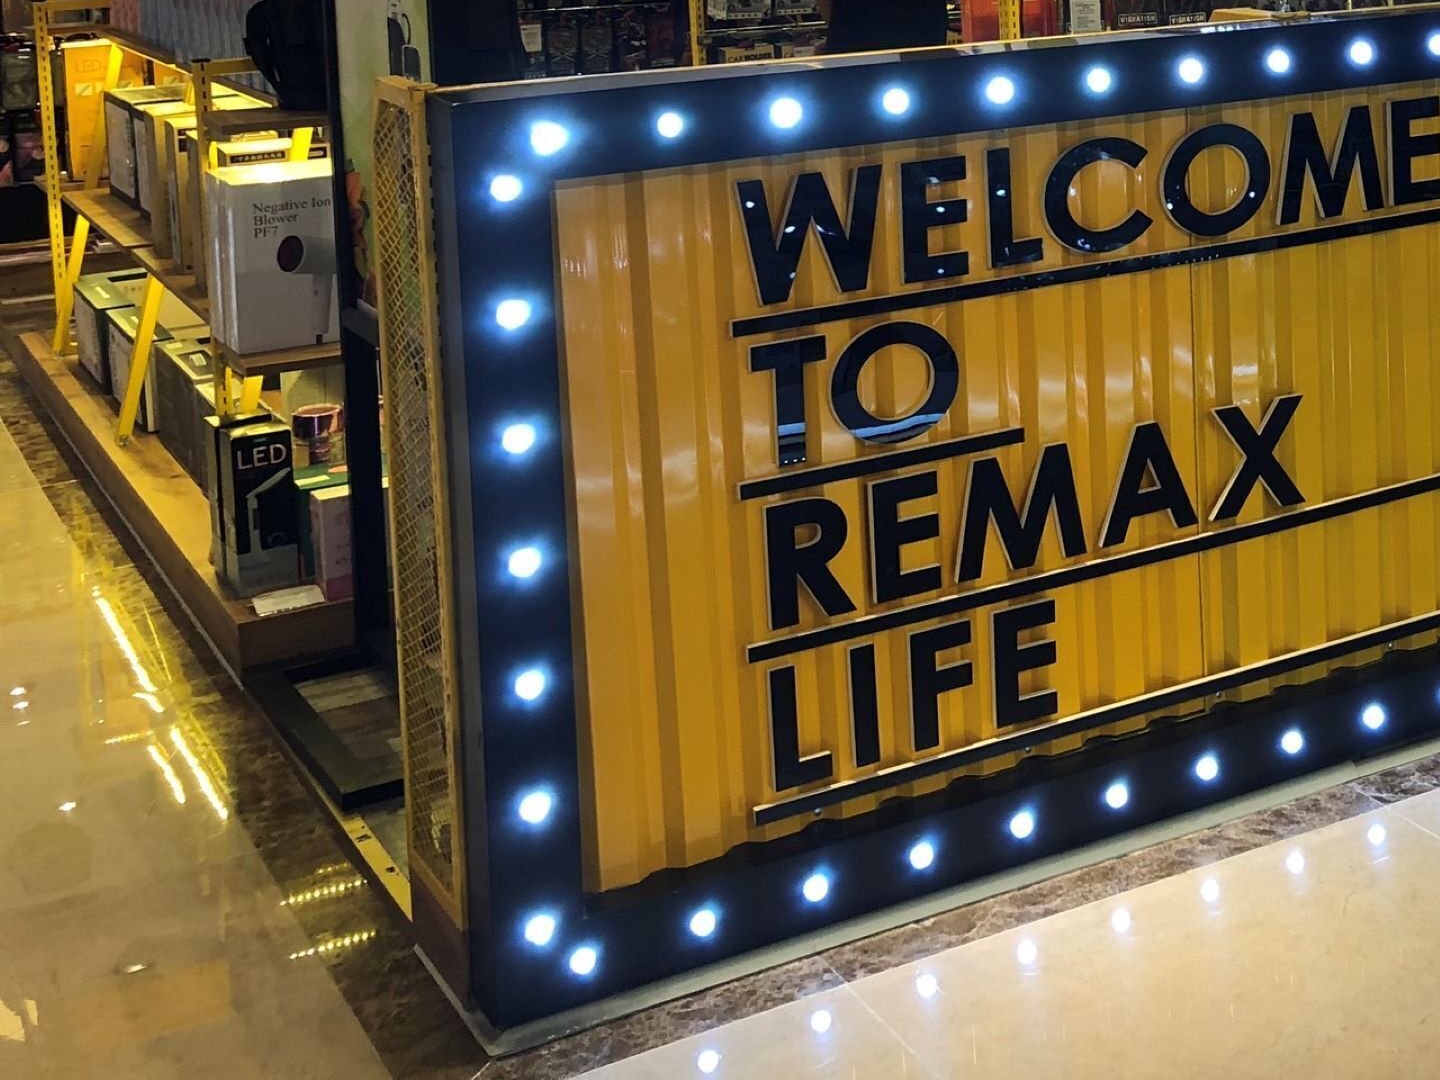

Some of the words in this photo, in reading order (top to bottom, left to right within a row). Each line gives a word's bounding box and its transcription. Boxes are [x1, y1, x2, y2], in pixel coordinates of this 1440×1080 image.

[253, 200, 307, 214] Negative
[311, 197, 332, 208] Ion
[253, 214, 299, 227] Blower
[253, 226, 279, 238] PF7
[748, 321, 961, 468] TO
[236, 444, 287, 470] LED
[764, 394, 1307, 631] REMAX
[766, 598, 1059, 793] LIFE
